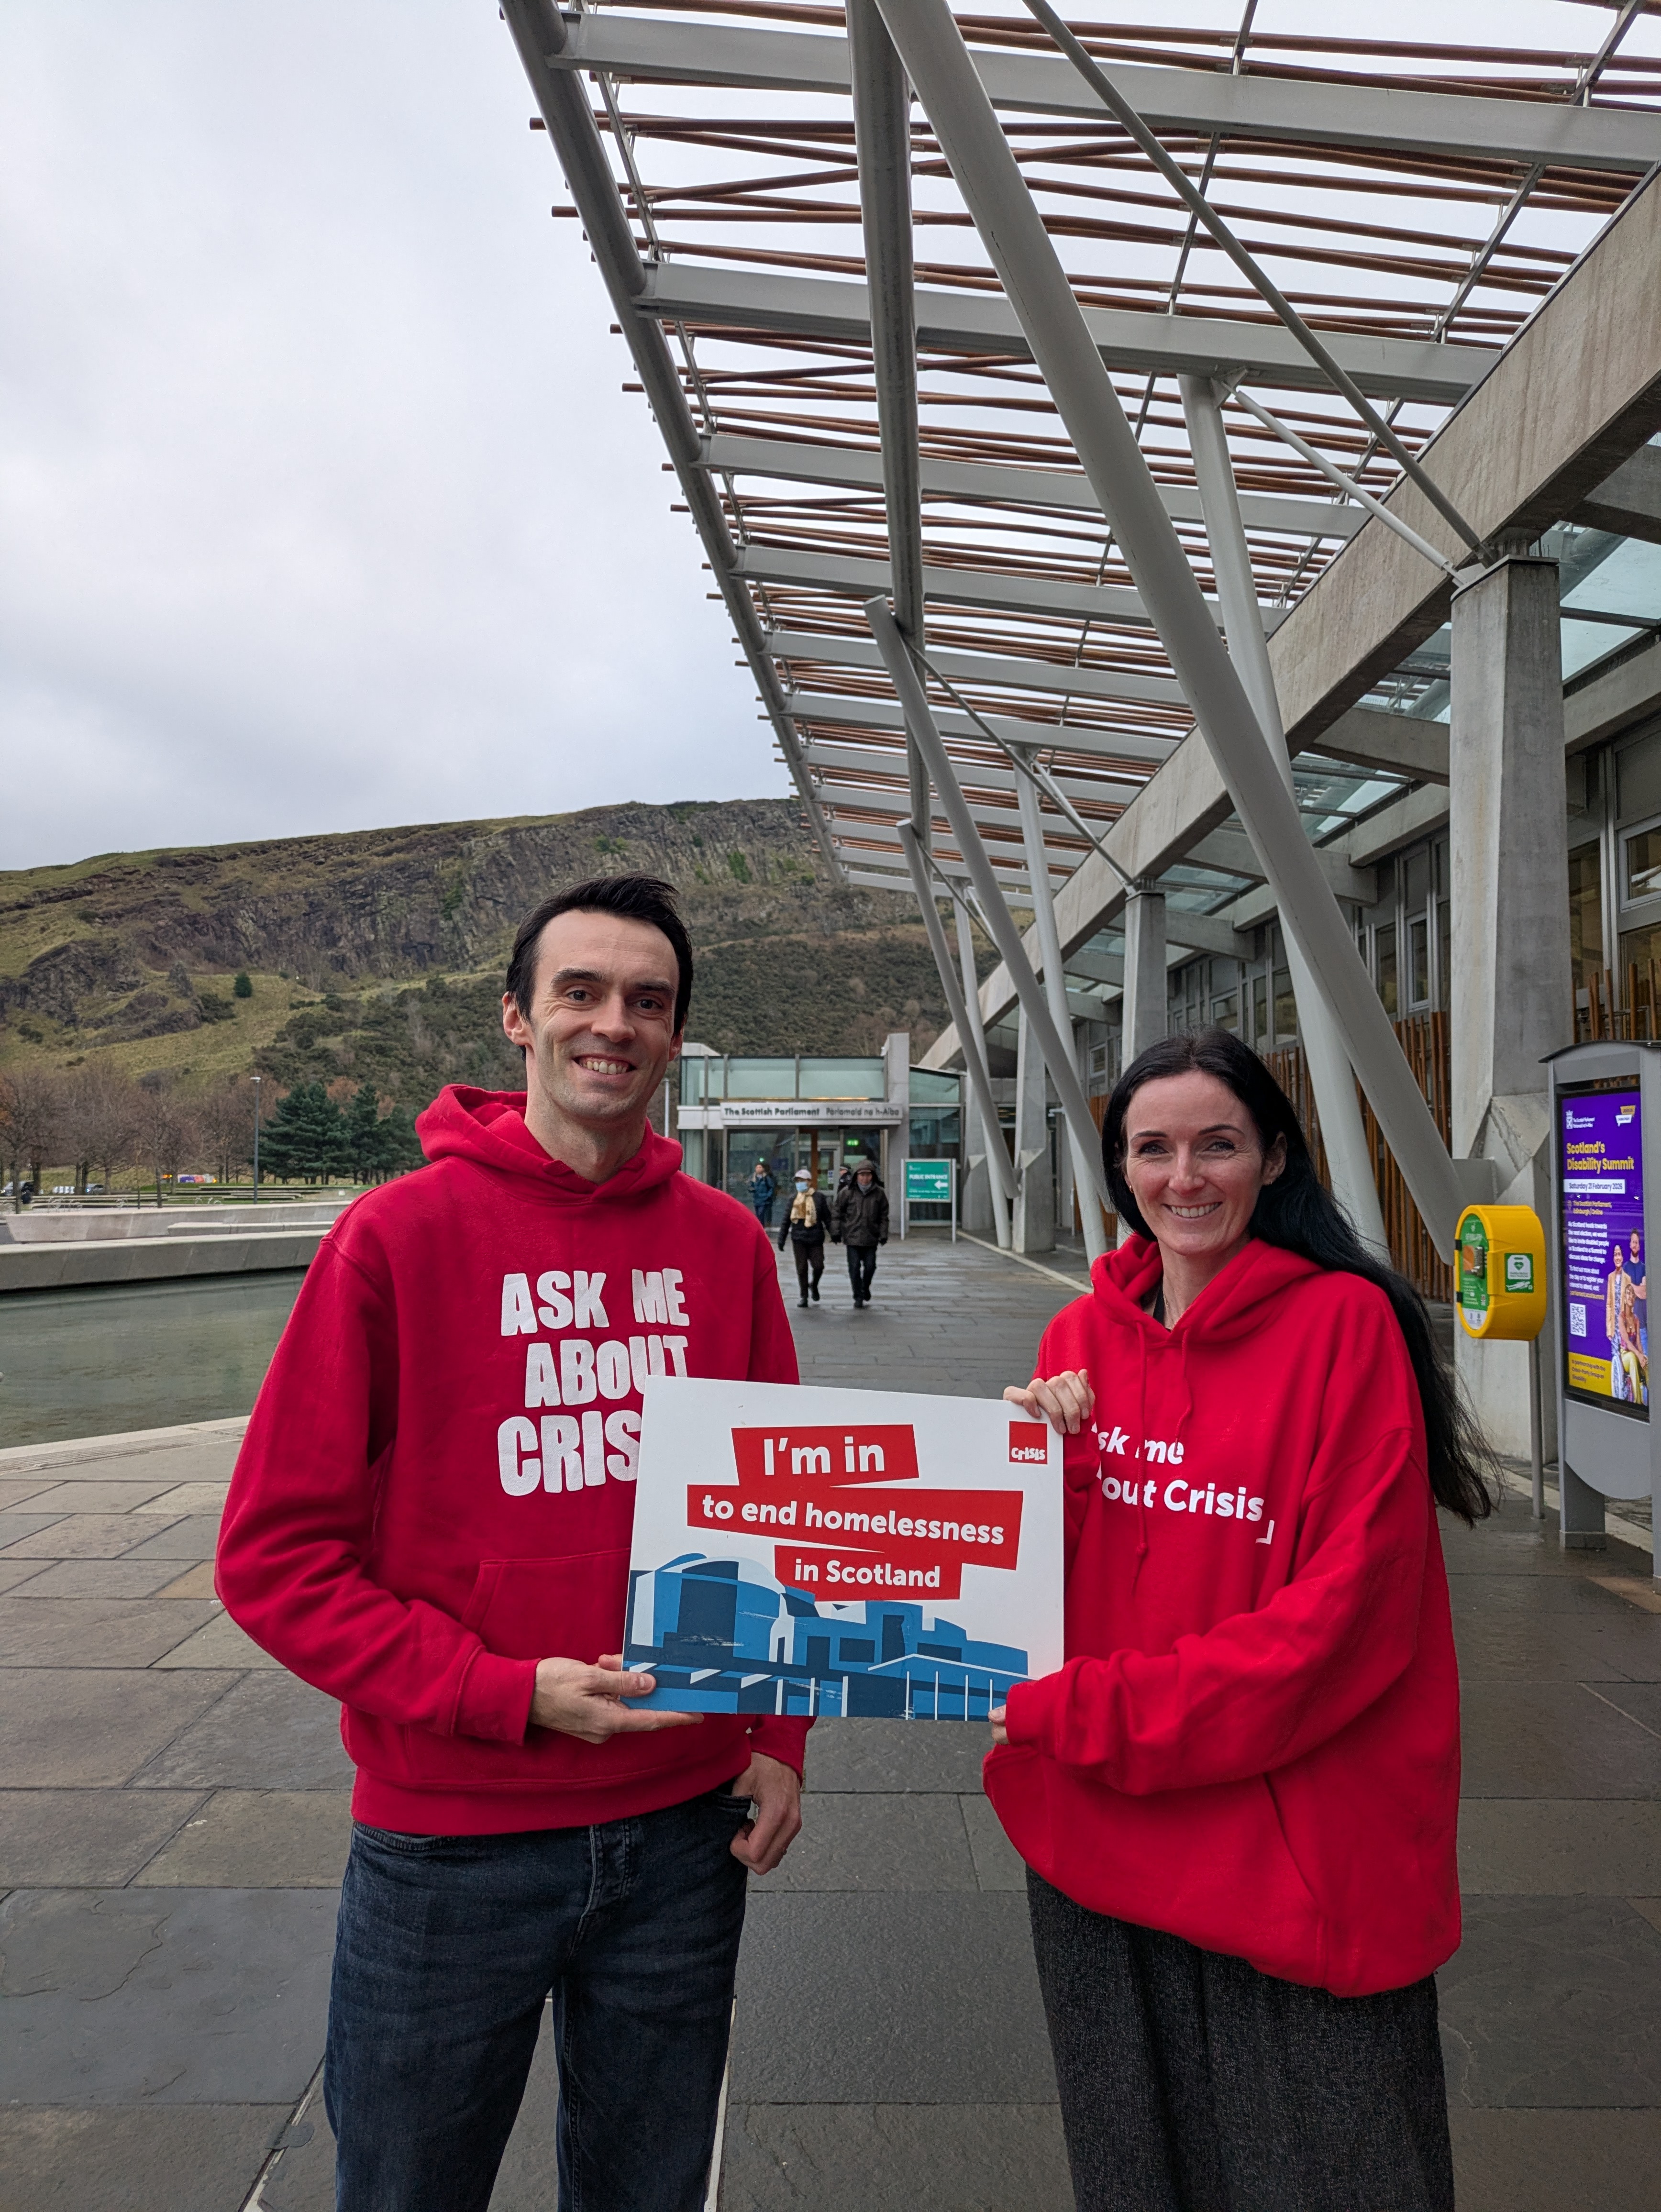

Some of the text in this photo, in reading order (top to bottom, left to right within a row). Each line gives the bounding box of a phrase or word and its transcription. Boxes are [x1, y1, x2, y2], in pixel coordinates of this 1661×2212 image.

[1567, 1140, 1605, 1154] Scotland's
[1567, 1156, 1635, 1174] Disability Summit
[1569, 1183, 1587, 1191] Saturday
[1593, 1183, 1612, 1192] February
[501, 1268, 690, 1336] ASK ME
[525, 1335, 688, 1408] ABOUT
[498, 1410, 642, 1496] CRIS
[844, 1436, 886, 1473] in
[1135, 1439, 1184, 1465] me
[1164, 1479, 1264, 1522] Crisis
[702, 1494, 1005, 1545] to end homelessness
[794, 1558, 941, 1589] in Scotland
